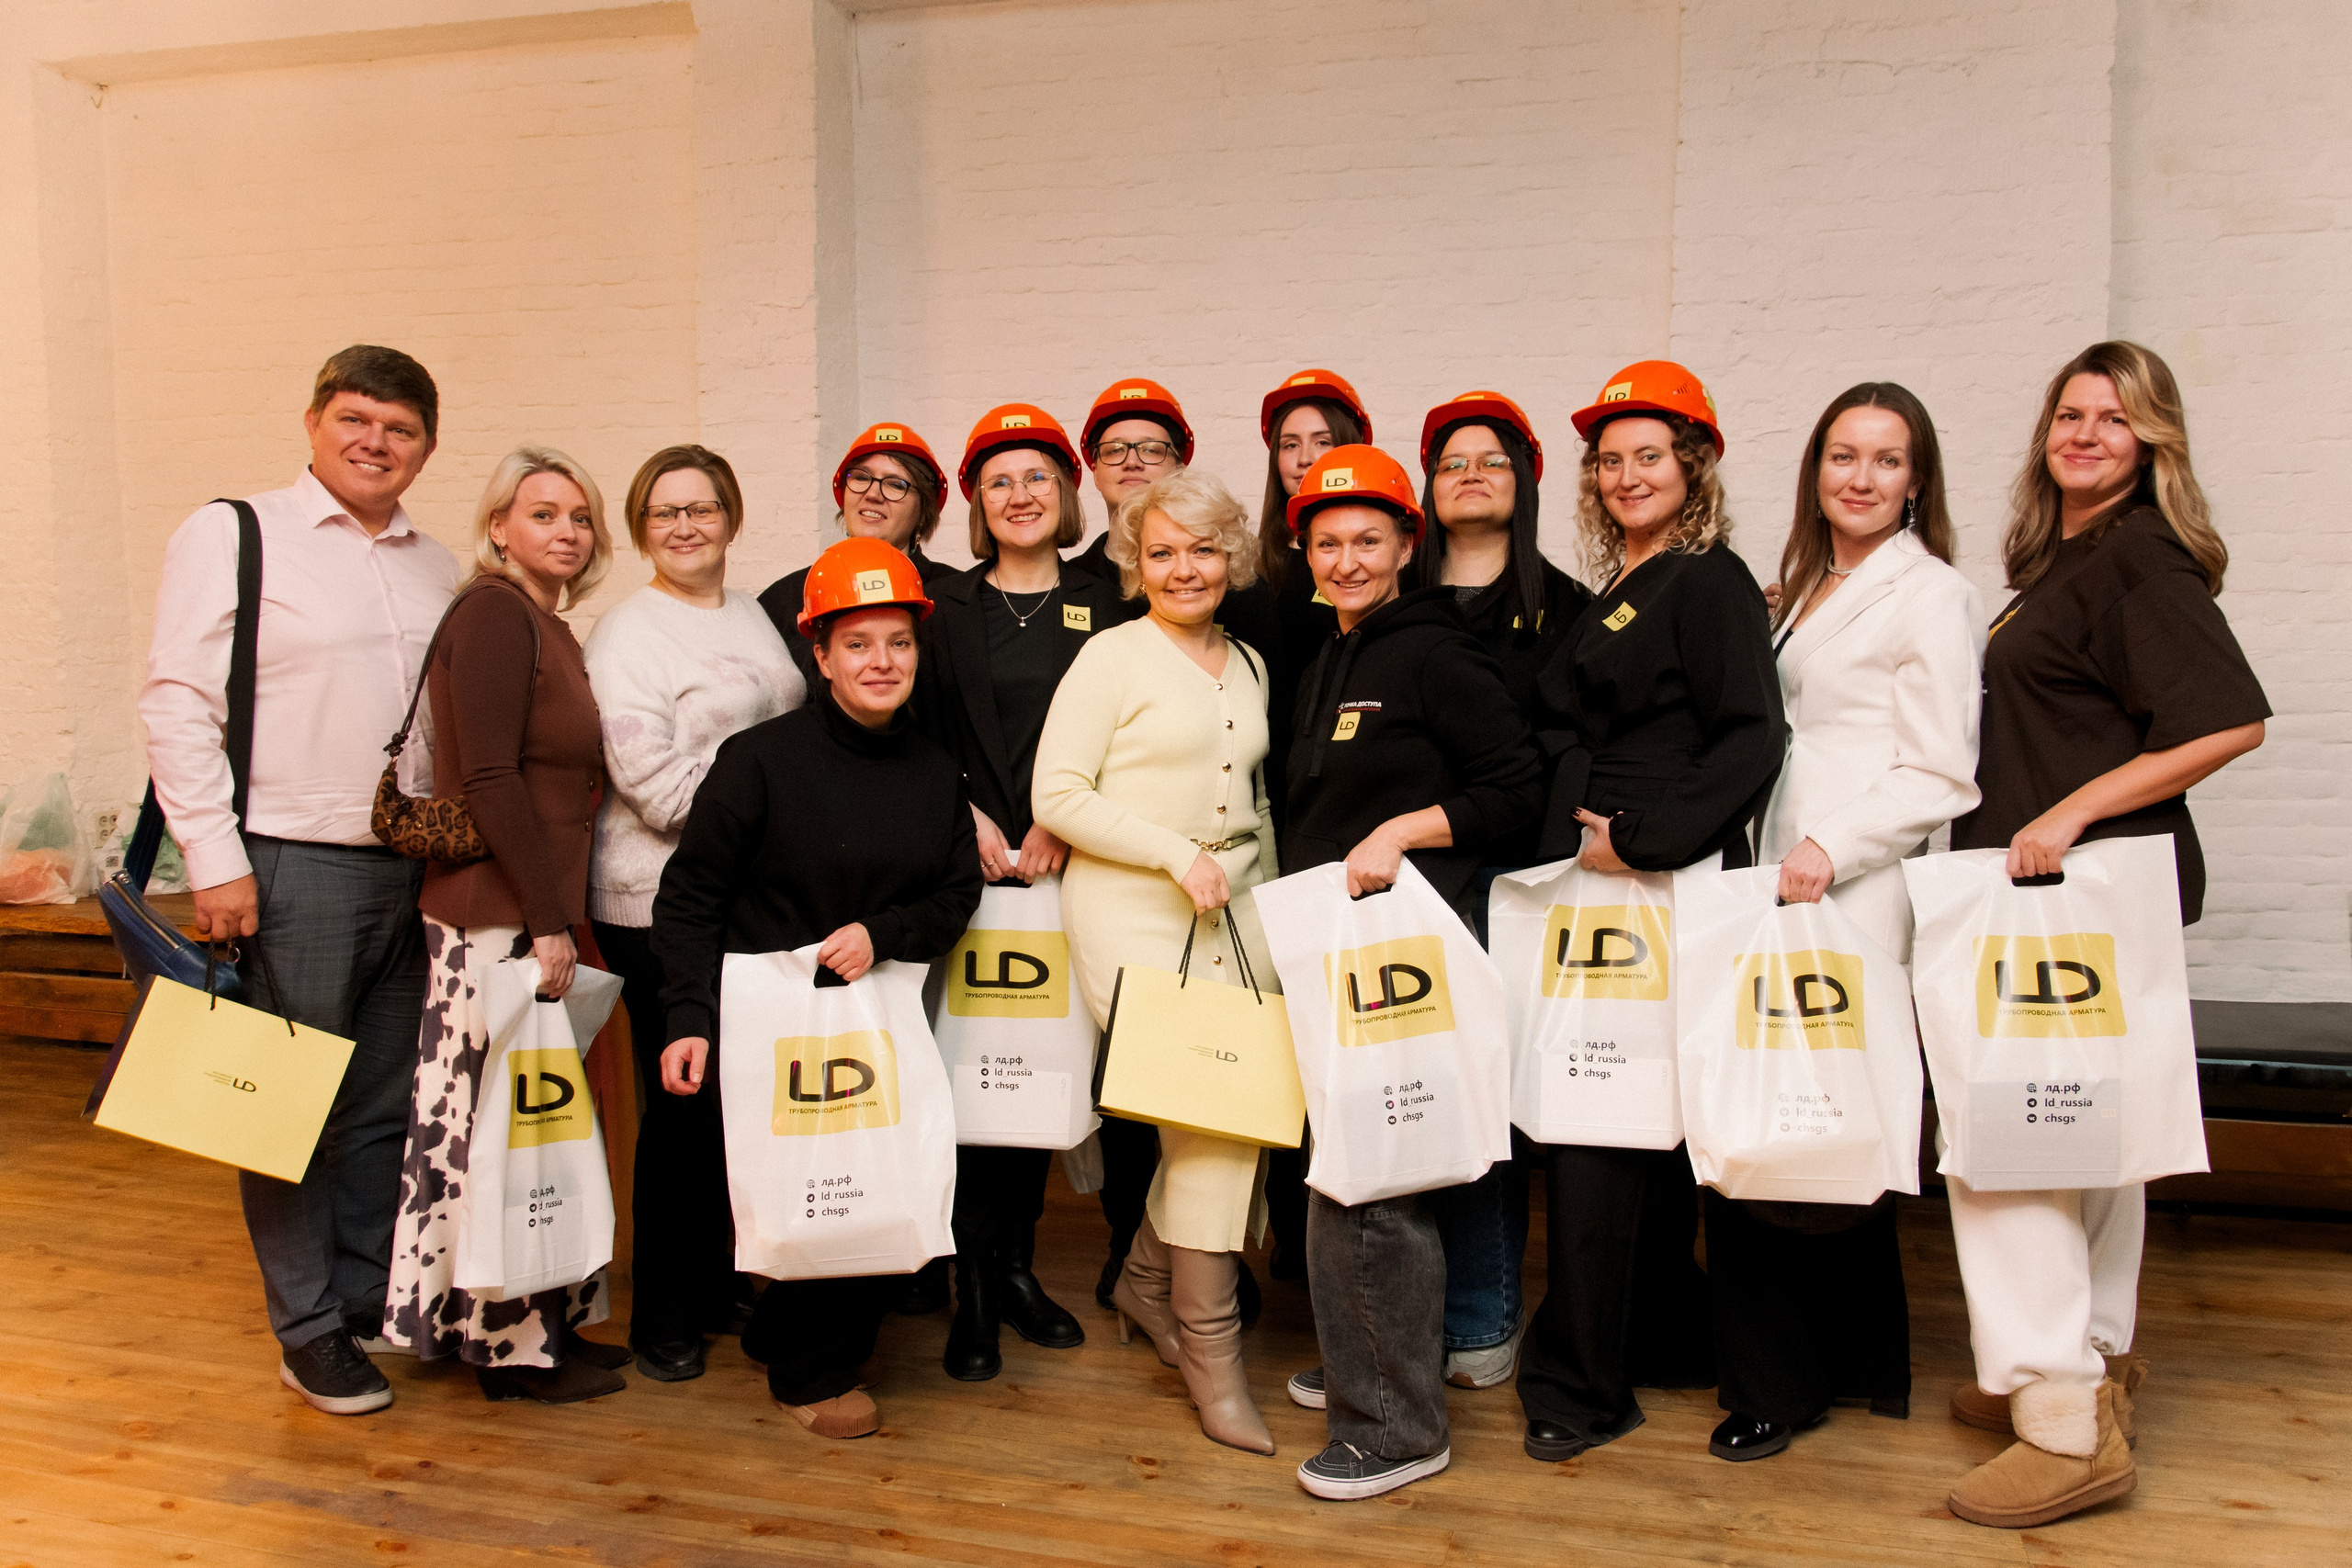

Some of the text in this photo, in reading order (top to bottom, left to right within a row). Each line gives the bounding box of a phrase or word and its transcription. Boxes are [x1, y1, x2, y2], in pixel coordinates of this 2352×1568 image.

[1326, 478, 1348, 487] LD
[863, 580, 886, 591] LD
[1068, 612, 1086, 621] LD
[1613, 611, 1627, 624] LD
[1340, 721, 1355, 730] LD
[1557, 928, 1648, 967] LD
[966, 950, 1049, 988] LD
[1995, 960, 2101, 1004] LD
[1345, 964, 1432, 1013] LD
[1754, 974, 1849, 1017] LD
[1408, 1006, 1437, 1015] АРМАТУРА
[1585, 1041, 1616, 1051] лд.рф
[995, 1055, 1023, 1066] лд.рф
[1216, 1050, 1238, 1062] LD
[1584, 1054, 1626, 1064] ld_russia
[994, 1068, 1033, 1077] ld_russia
[1584, 1068, 1611, 1079] chsgs
[232, 1077, 257, 1092] LD
[789, 1058, 876, 1101] LD
[995, 1082, 1019, 1091] chsgs
[1399, 1079, 1423, 1093] лд.рф
[2044, 1082, 2081, 1094] лд.рф
[516, 1072, 574, 1114] LD
[844, 1101, 877, 1110] АРМАТУРА
[1400, 1093, 1434, 1107] ld_russia
[2044, 1098, 2093, 1109] ld_russia
[1402, 1111, 1423, 1122] chsgs
[2044, 1113, 2075, 1125] chsgs
[821, 1175, 852, 1186] лд.рф
[821, 1189, 864, 1201] ld_russia
[821, 1207, 850, 1217] chsgs
